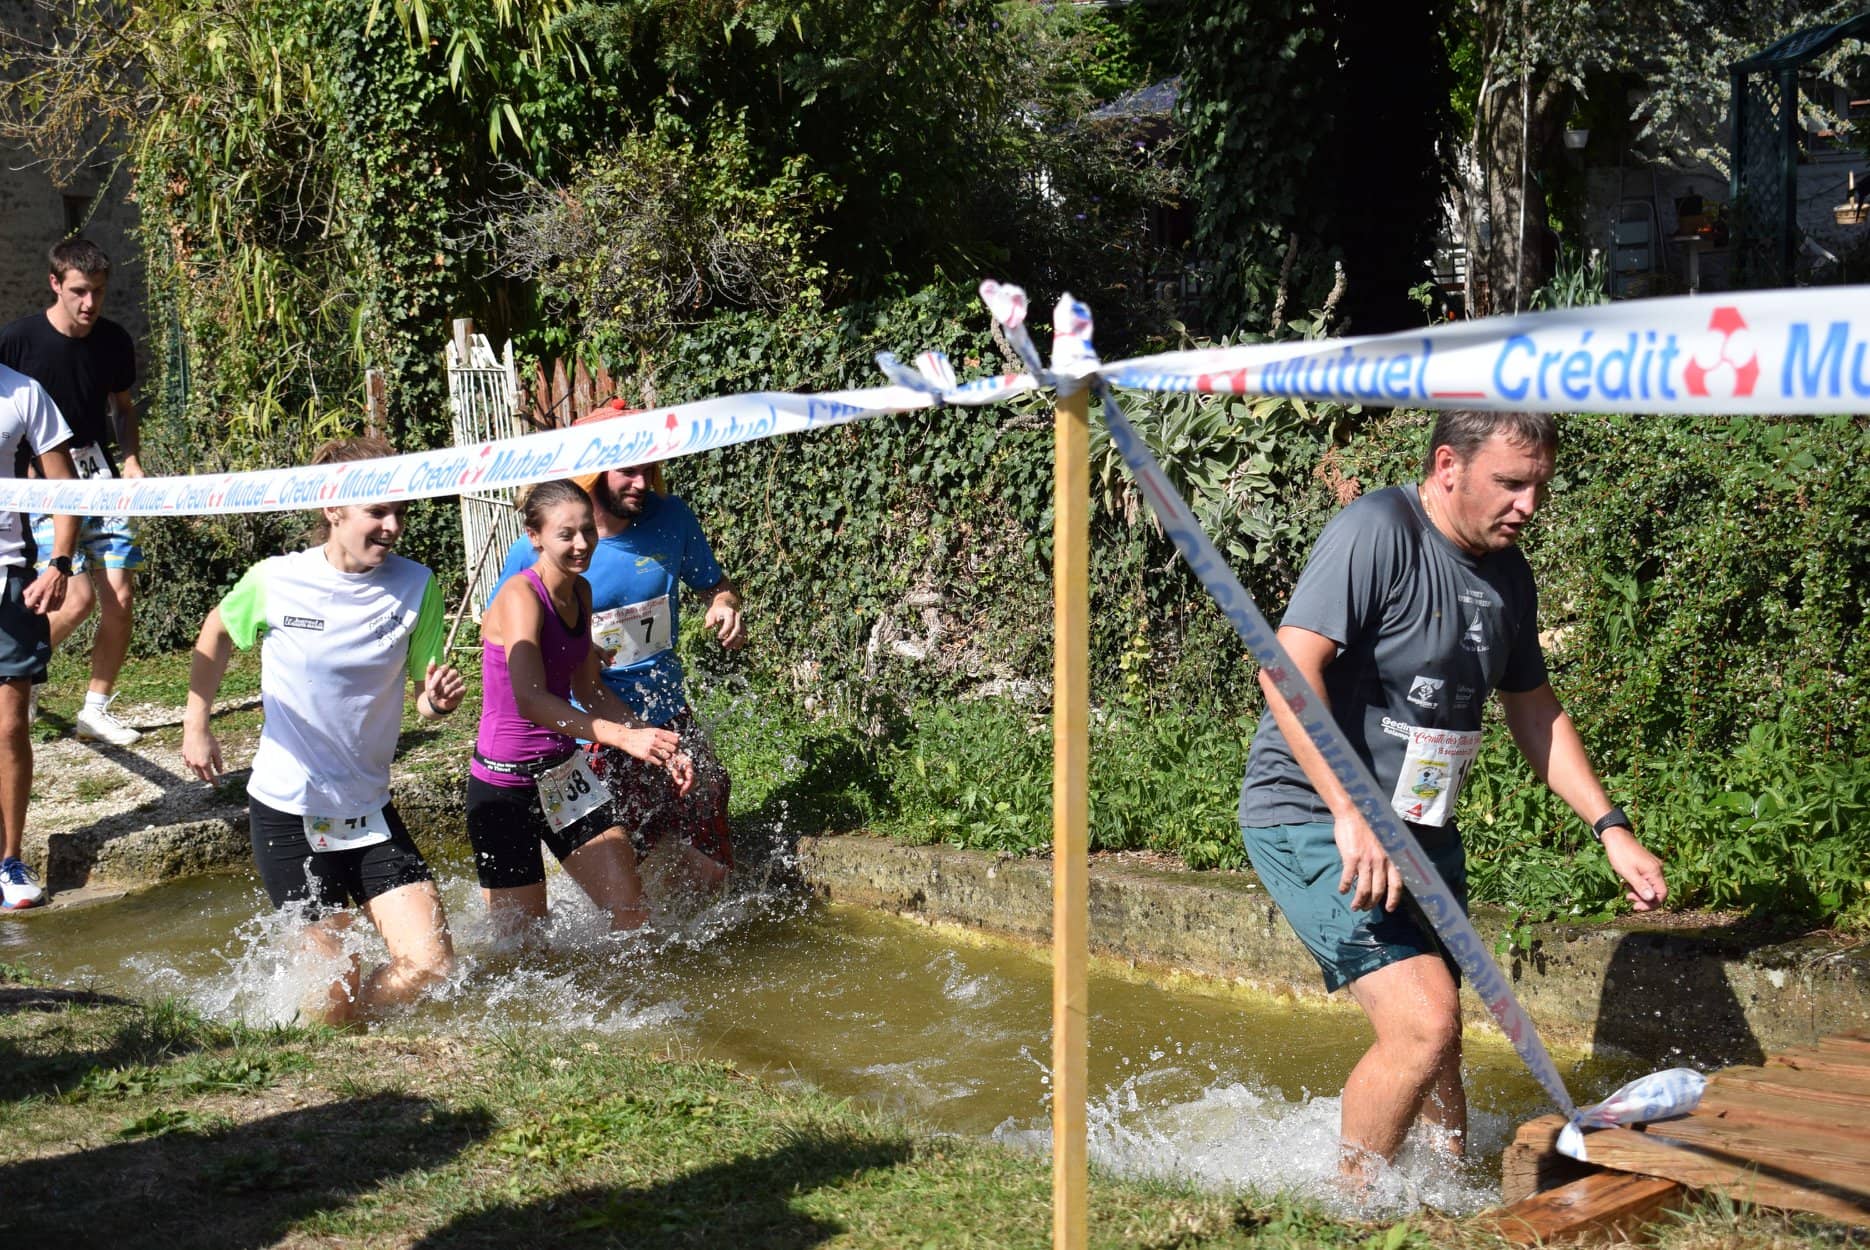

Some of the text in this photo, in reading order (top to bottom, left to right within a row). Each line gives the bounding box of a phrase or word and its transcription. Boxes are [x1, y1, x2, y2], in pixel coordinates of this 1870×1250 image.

[1260, 338, 1433, 399] Mutuel
[1492, 329, 1679, 400] Crédit
[79, 456, 101, 478] 34
[337, 464, 402, 499] Mutuel
[408, 455, 468, 493] Crédit
[482, 442, 565, 483] Mutuel
[573, 430, 655, 470] Crédit
[640, 616, 655, 644] 7
